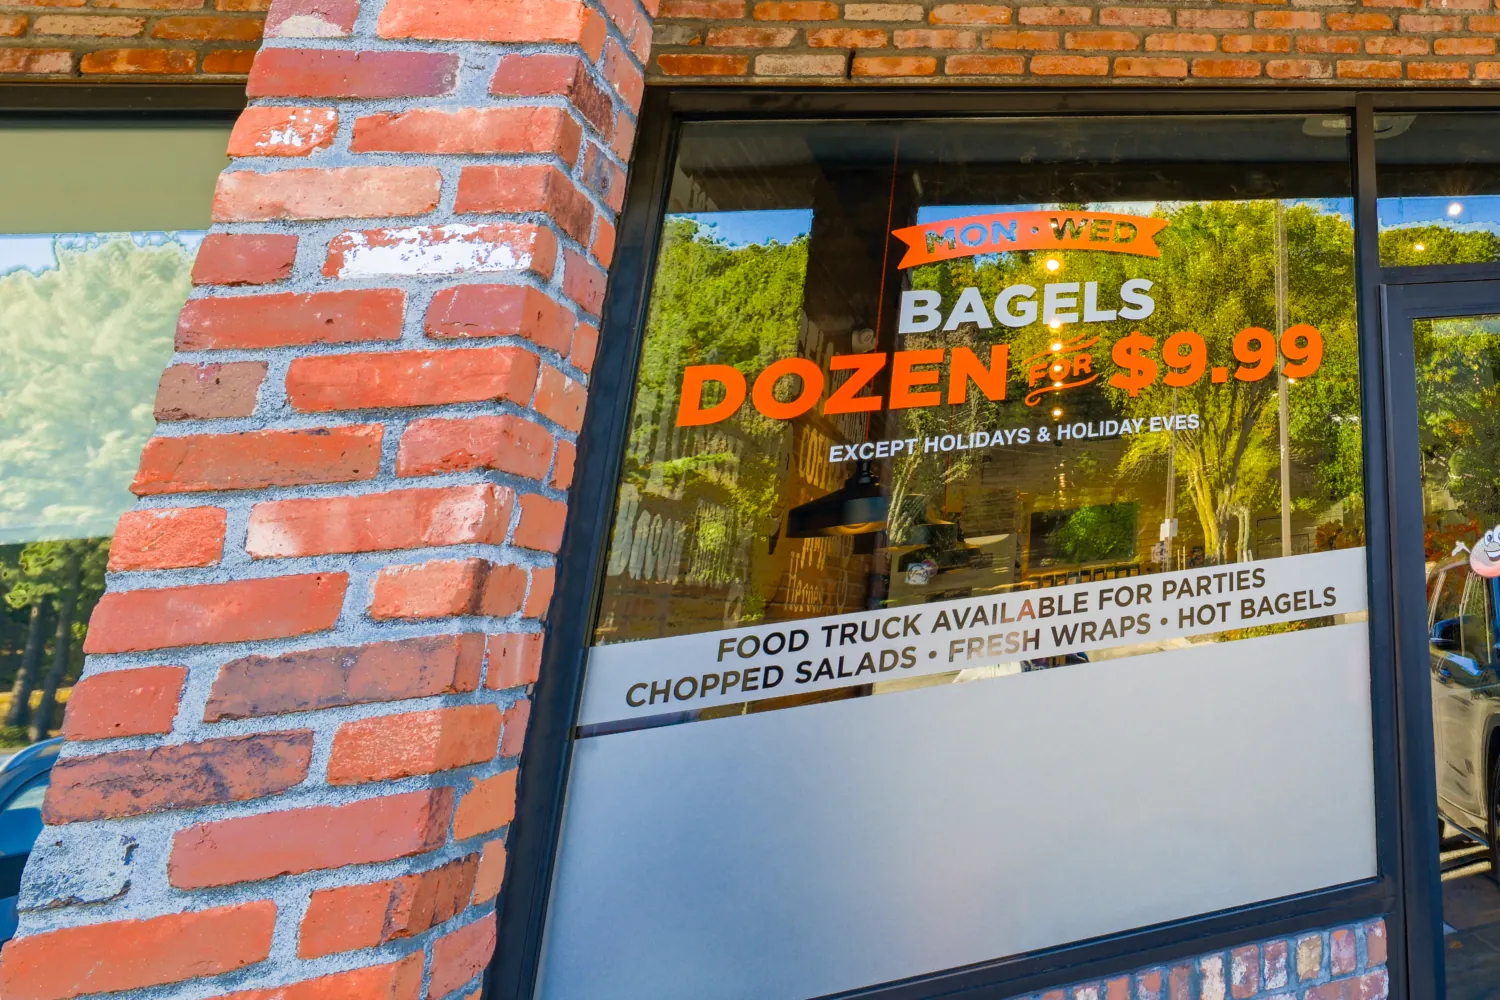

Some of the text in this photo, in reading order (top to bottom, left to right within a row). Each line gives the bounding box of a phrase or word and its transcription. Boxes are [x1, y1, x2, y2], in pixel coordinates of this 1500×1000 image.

[925, 218, 1138, 253] MON WED
[899, 279, 1156, 334] BAGELS
[676, 324, 1324, 427] DOZEN FOR $9.99
[829, 414, 1200, 463] EXCEPT HOLIDAYS & HOLIDAY EVES
[626, 586, 1338, 709] CHOPPED SALADS FRESH WRAPS HOT BAGELS
[718, 568, 1266, 661] FOOD TRUCK AVAILABLE FOR PARTIES
